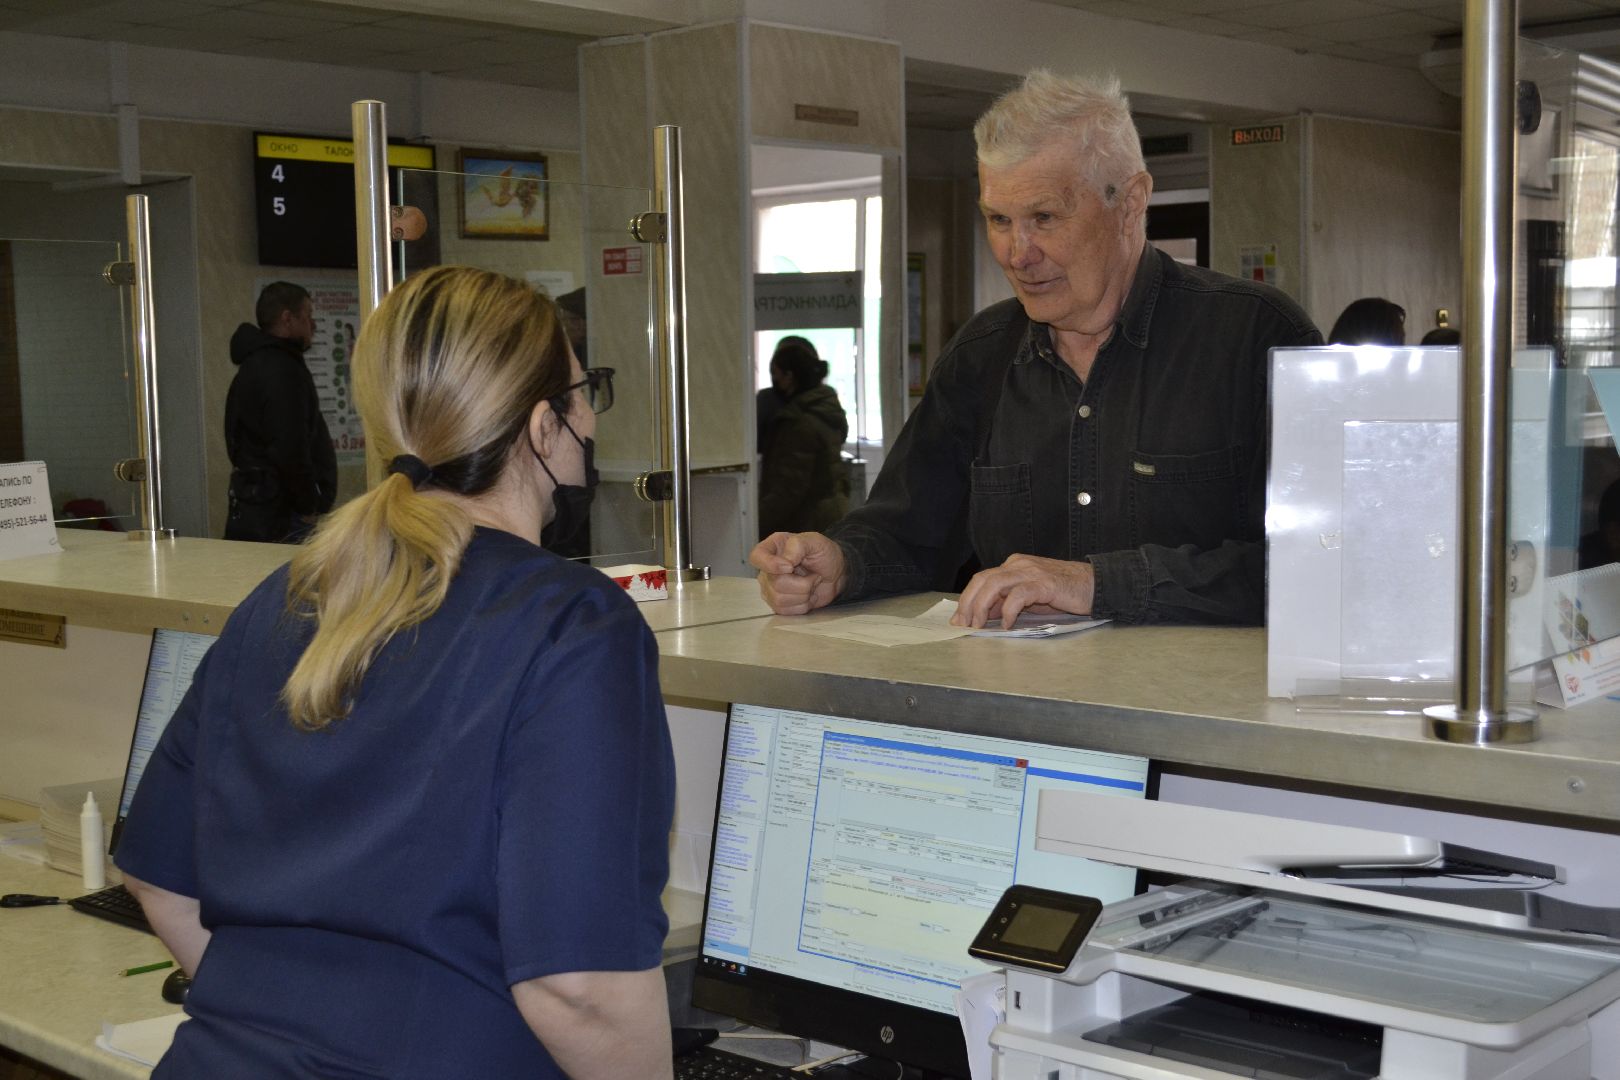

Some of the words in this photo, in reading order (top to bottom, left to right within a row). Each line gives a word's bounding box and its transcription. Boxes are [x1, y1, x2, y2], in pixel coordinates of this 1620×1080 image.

[1234, 128, 1281, 144] ВЫХОД
[270, 142, 299, 153] ОКНО
[271, 164, 285, 183] 4
[273, 197, 286, 216] 5
[22, 475, 32, 486] ПО
